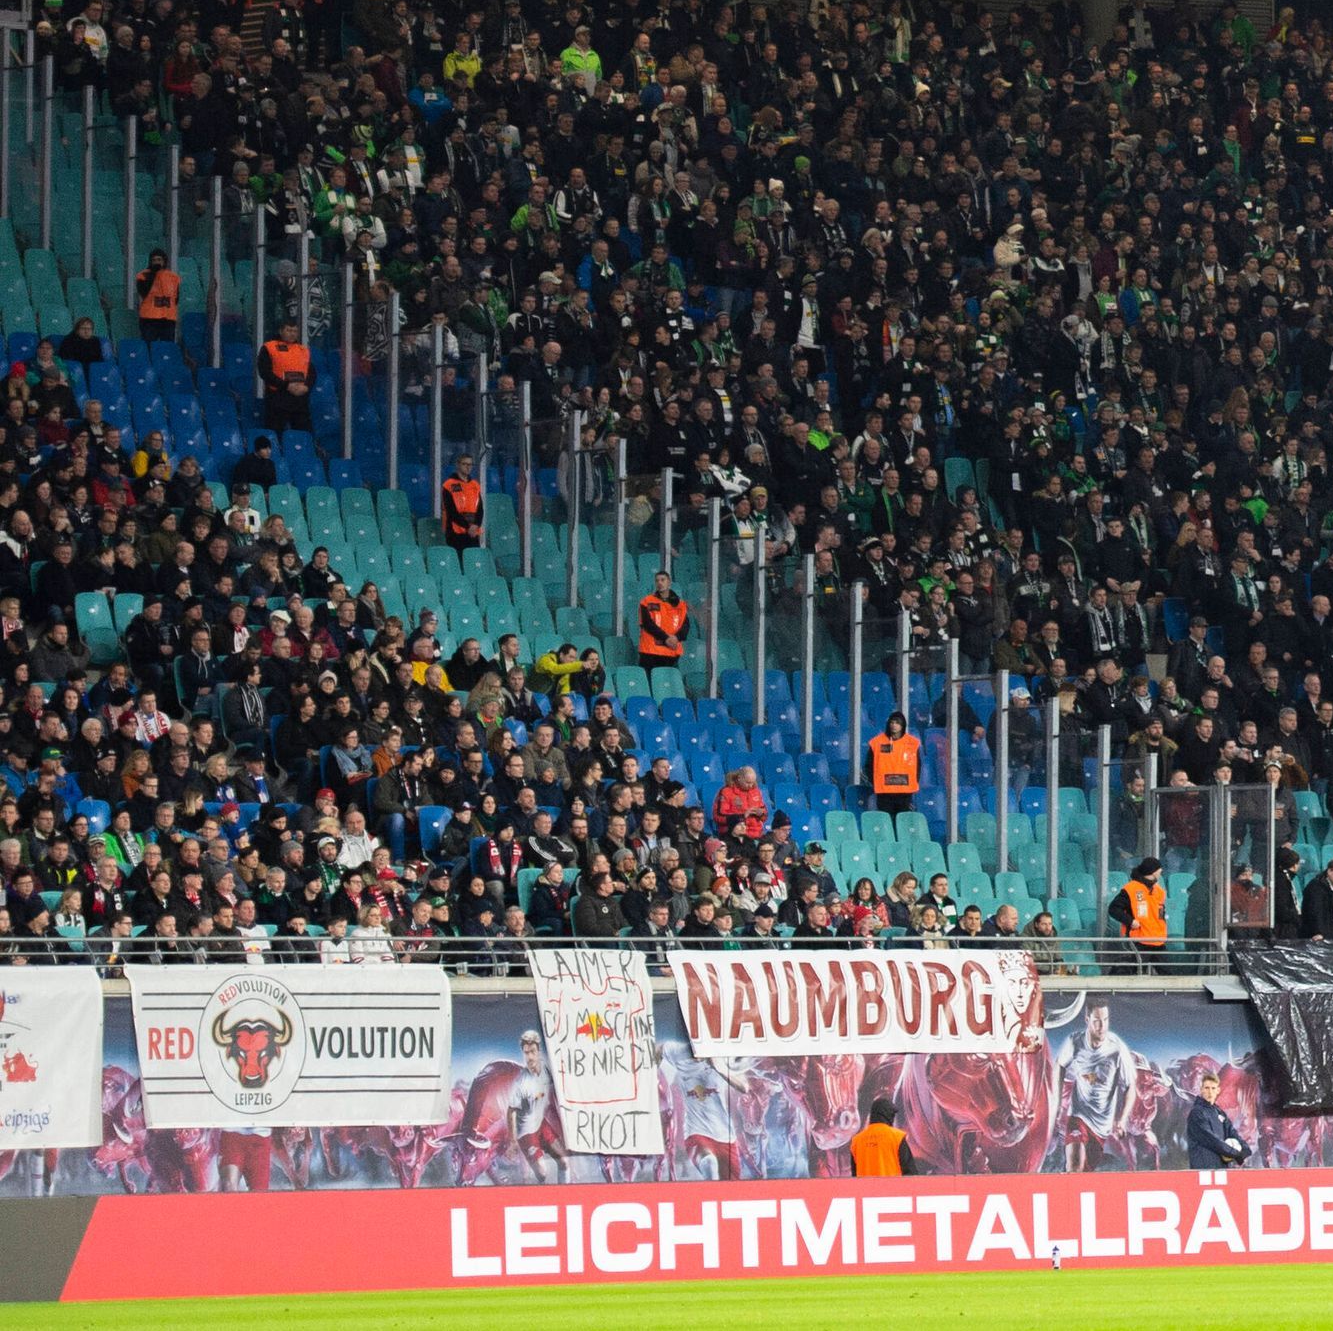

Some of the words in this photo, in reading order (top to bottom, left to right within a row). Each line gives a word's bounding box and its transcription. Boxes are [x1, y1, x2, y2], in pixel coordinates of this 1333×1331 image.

[531, 950, 635, 993] LAIMER
[218, 980, 288, 1006] REDVOLUTION
[681, 958, 996, 1043] NAUMBURG
[147, 1026, 195, 1061] RED
[310, 1024, 435, 1060] VOLUTION
[592, 1045, 631, 1076] MIR
[235, 1092, 272, 1106] LEIPZIG
[0, 1105, 51, 1135] eipzigs
